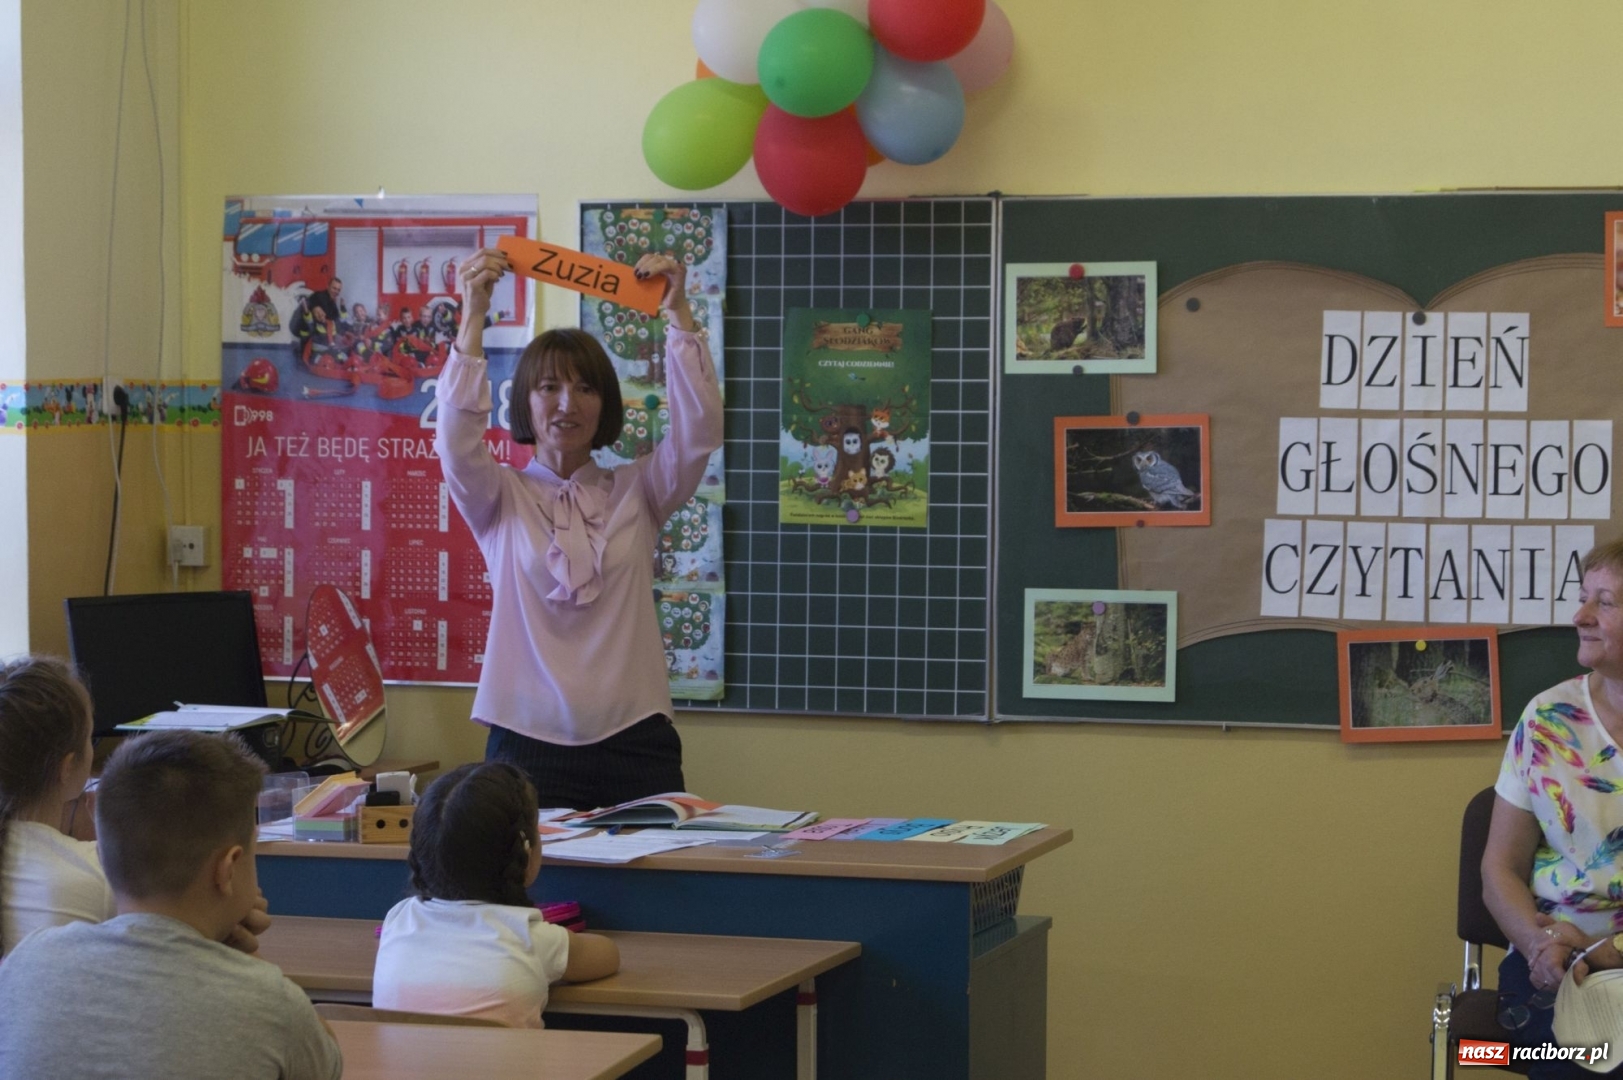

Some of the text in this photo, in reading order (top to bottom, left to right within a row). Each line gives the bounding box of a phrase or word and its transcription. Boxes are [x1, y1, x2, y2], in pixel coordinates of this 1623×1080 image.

[531, 248, 621, 295] Zuzia
[843, 326, 874, 335] GANG
[818, 360, 845, 368] CZYTAJ
[1321, 325, 1530, 389] DZIEŃ
[251, 410, 274, 422] 998
[246, 436, 268, 458] JA
[274, 432, 310, 457] TEŻ
[317, 437, 370, 464] BĘDĘ
[1279, 431, 1610, 497] GŁOŚNEGO
[1264, 543, 1584, 602] CZYTANIA
